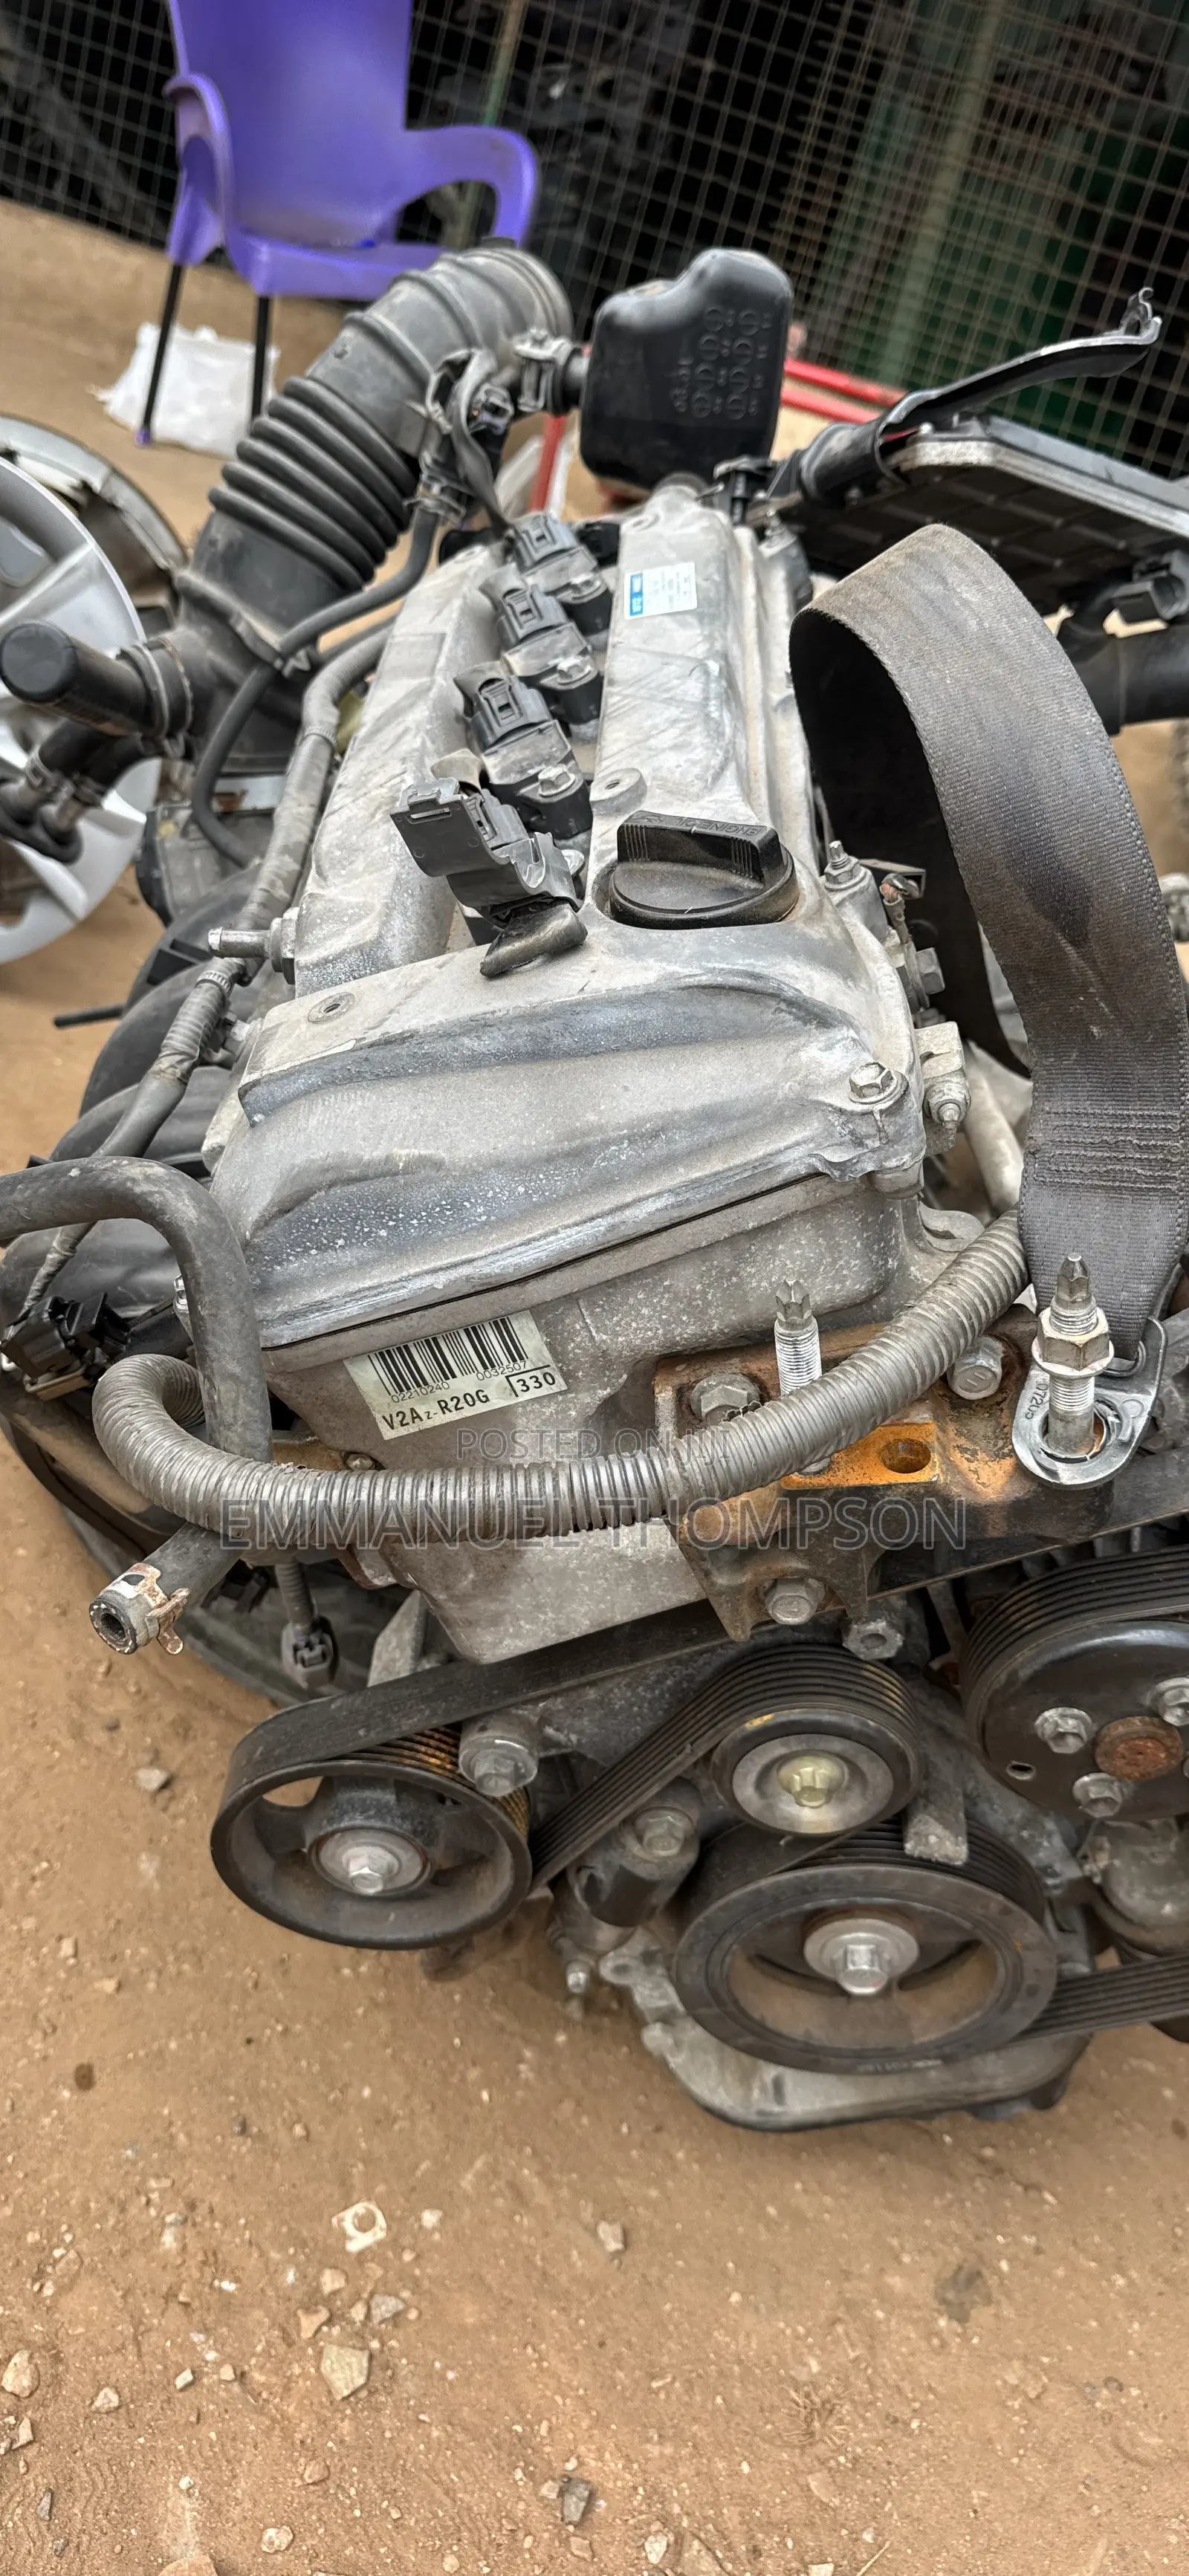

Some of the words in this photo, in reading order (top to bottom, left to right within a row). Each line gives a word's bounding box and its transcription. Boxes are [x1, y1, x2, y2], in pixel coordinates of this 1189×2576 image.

[697, 820, 762, 836] ENGINE
[392, 1381, 450, 1404] 02210240
[476, 1360, 528, 1382] 0032507
[516, 1372, 557, 1392] 330
